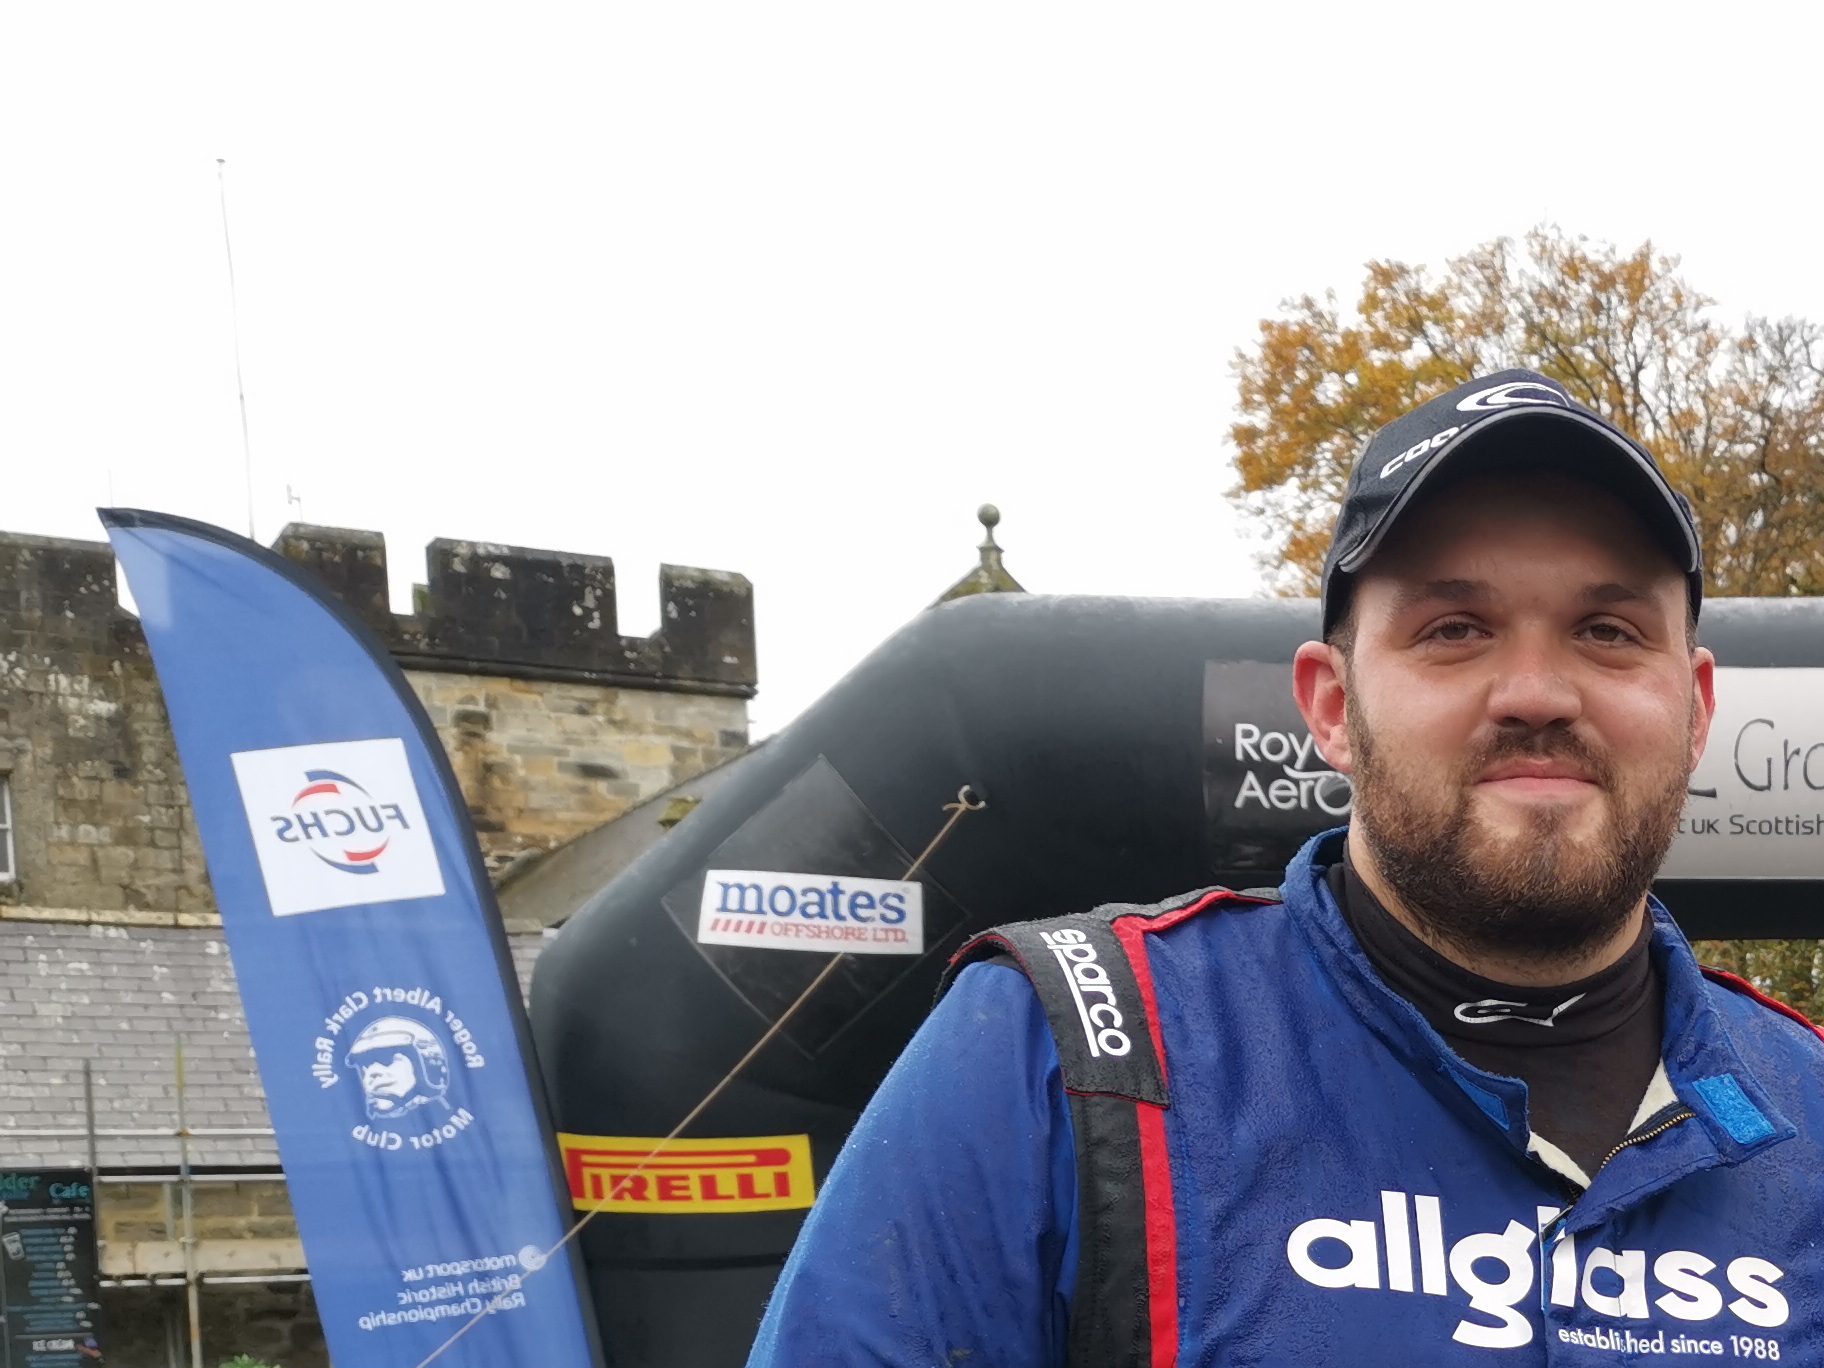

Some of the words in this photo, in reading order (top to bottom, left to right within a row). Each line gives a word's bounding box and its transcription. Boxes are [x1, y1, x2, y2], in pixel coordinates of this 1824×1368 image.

[1235, 723, 1326, 770] Roy
[716, 880, 906, 925] moates
[769, 921, 868, 941] OFFSHORE
[1043, 929, 1131, 1056] sparco
[565, 1147, 791, 1201] PIRELLI
[1287, 1190, 1789, 1349] allglass
[1671, 1333, 1724, 1355] since
[1730, 1335, 1780, 1361] 1988
